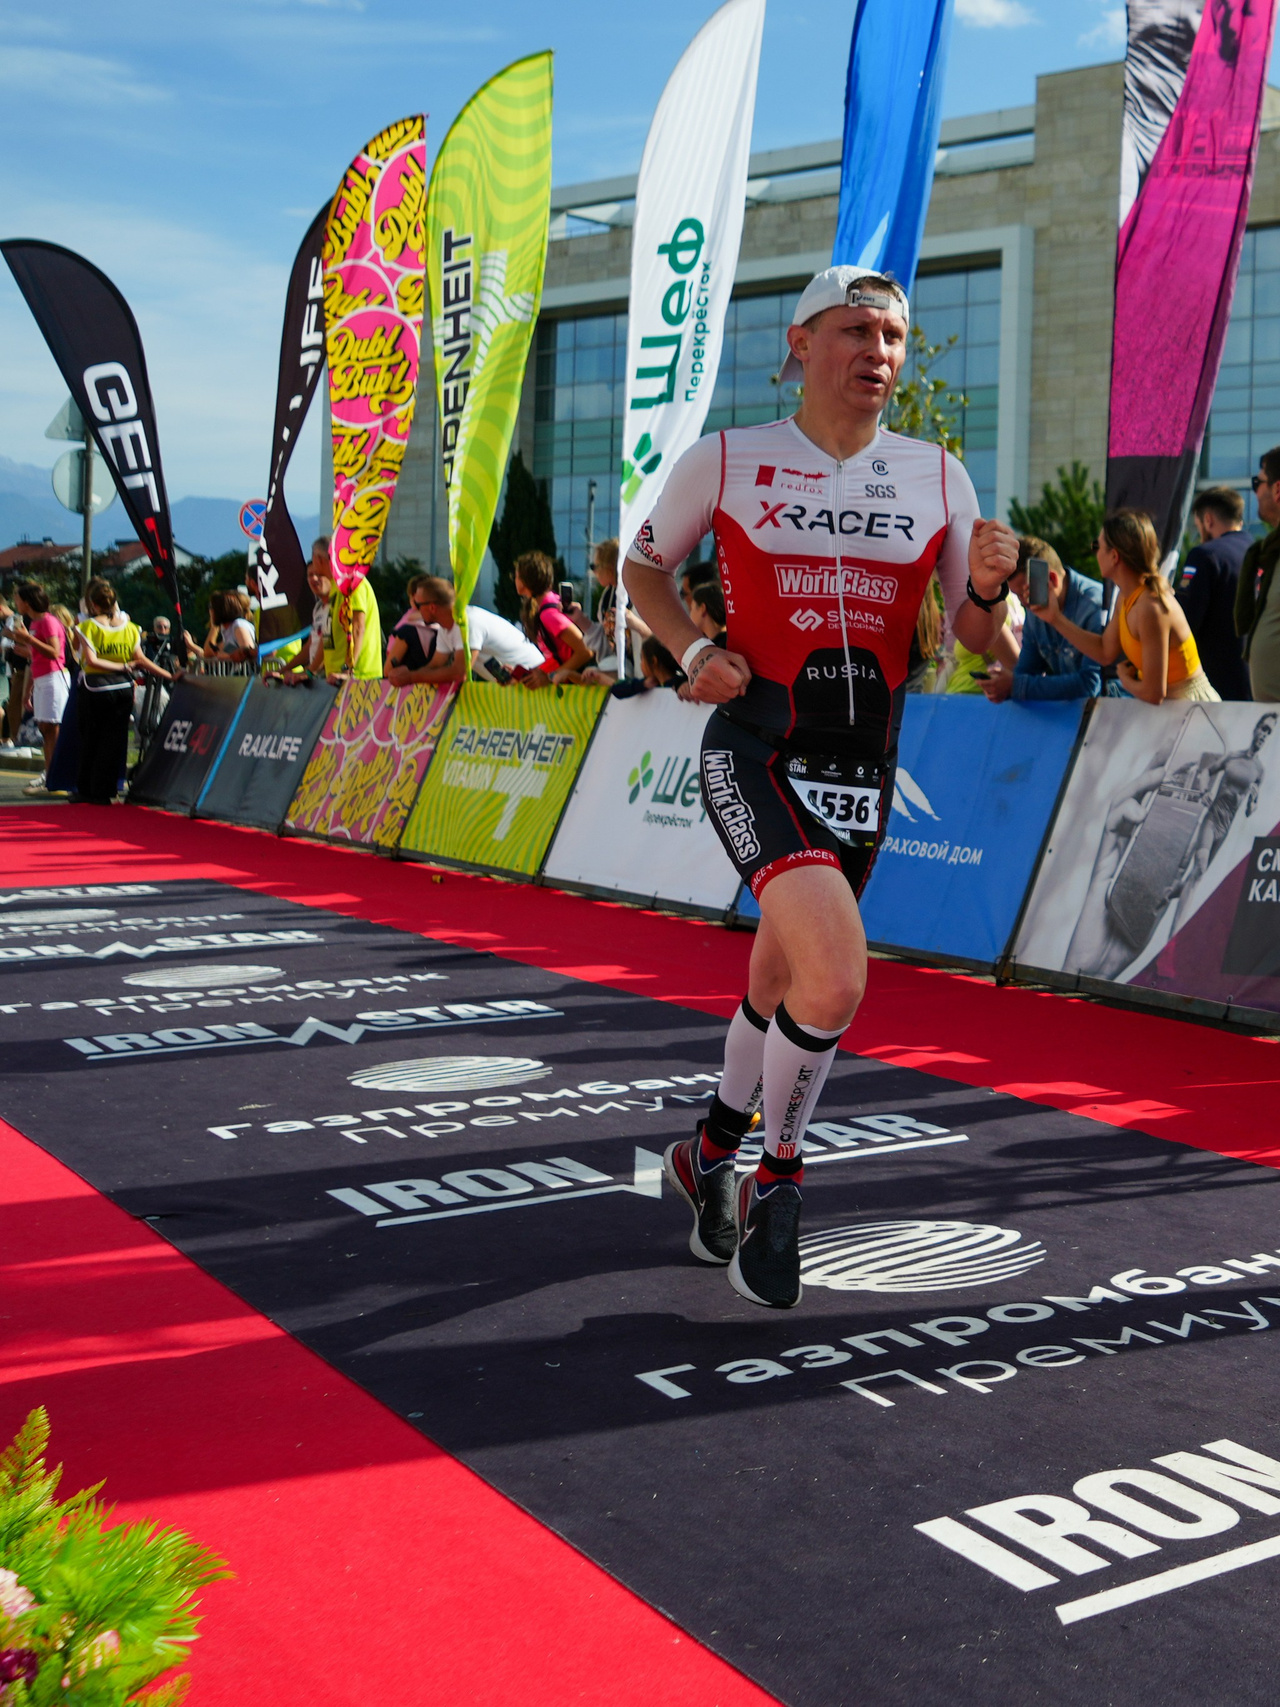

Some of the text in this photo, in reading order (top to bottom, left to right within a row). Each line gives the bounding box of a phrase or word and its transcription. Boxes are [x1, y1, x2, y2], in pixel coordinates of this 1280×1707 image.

[630, 217, 705, 410] Шеф
[327, 322, 404, 366] Dubl
[331, 358, 413, 414] Bubl
[780, 482, 824, 495] redfox
[864, 483, 897, 499] SGS
[752, 500, 915, 541] XRACER
[827, 608, 886, 628] SNARA
[806, 663, 878, 680] RUSSIA
[163, 719, 193, 753] GEL
[450, 726, 574, 765] FAHRENHEIT
[442, 759, 496, 790] VITAMIN
[787, 849, 835, 862] XRACER
[947, 846, 984, 866] ДОМ
[155, 929, 319, 946] STAR
[0, 972, 450, 1014] Газпромбанк
[95, 984, 408, 1016] Премиум
[63, 999, 556, 1055] IRON STAR
[206, 1071, 726, 1141] Газпромбан
[325, 1156, 614, 1217] IRON
